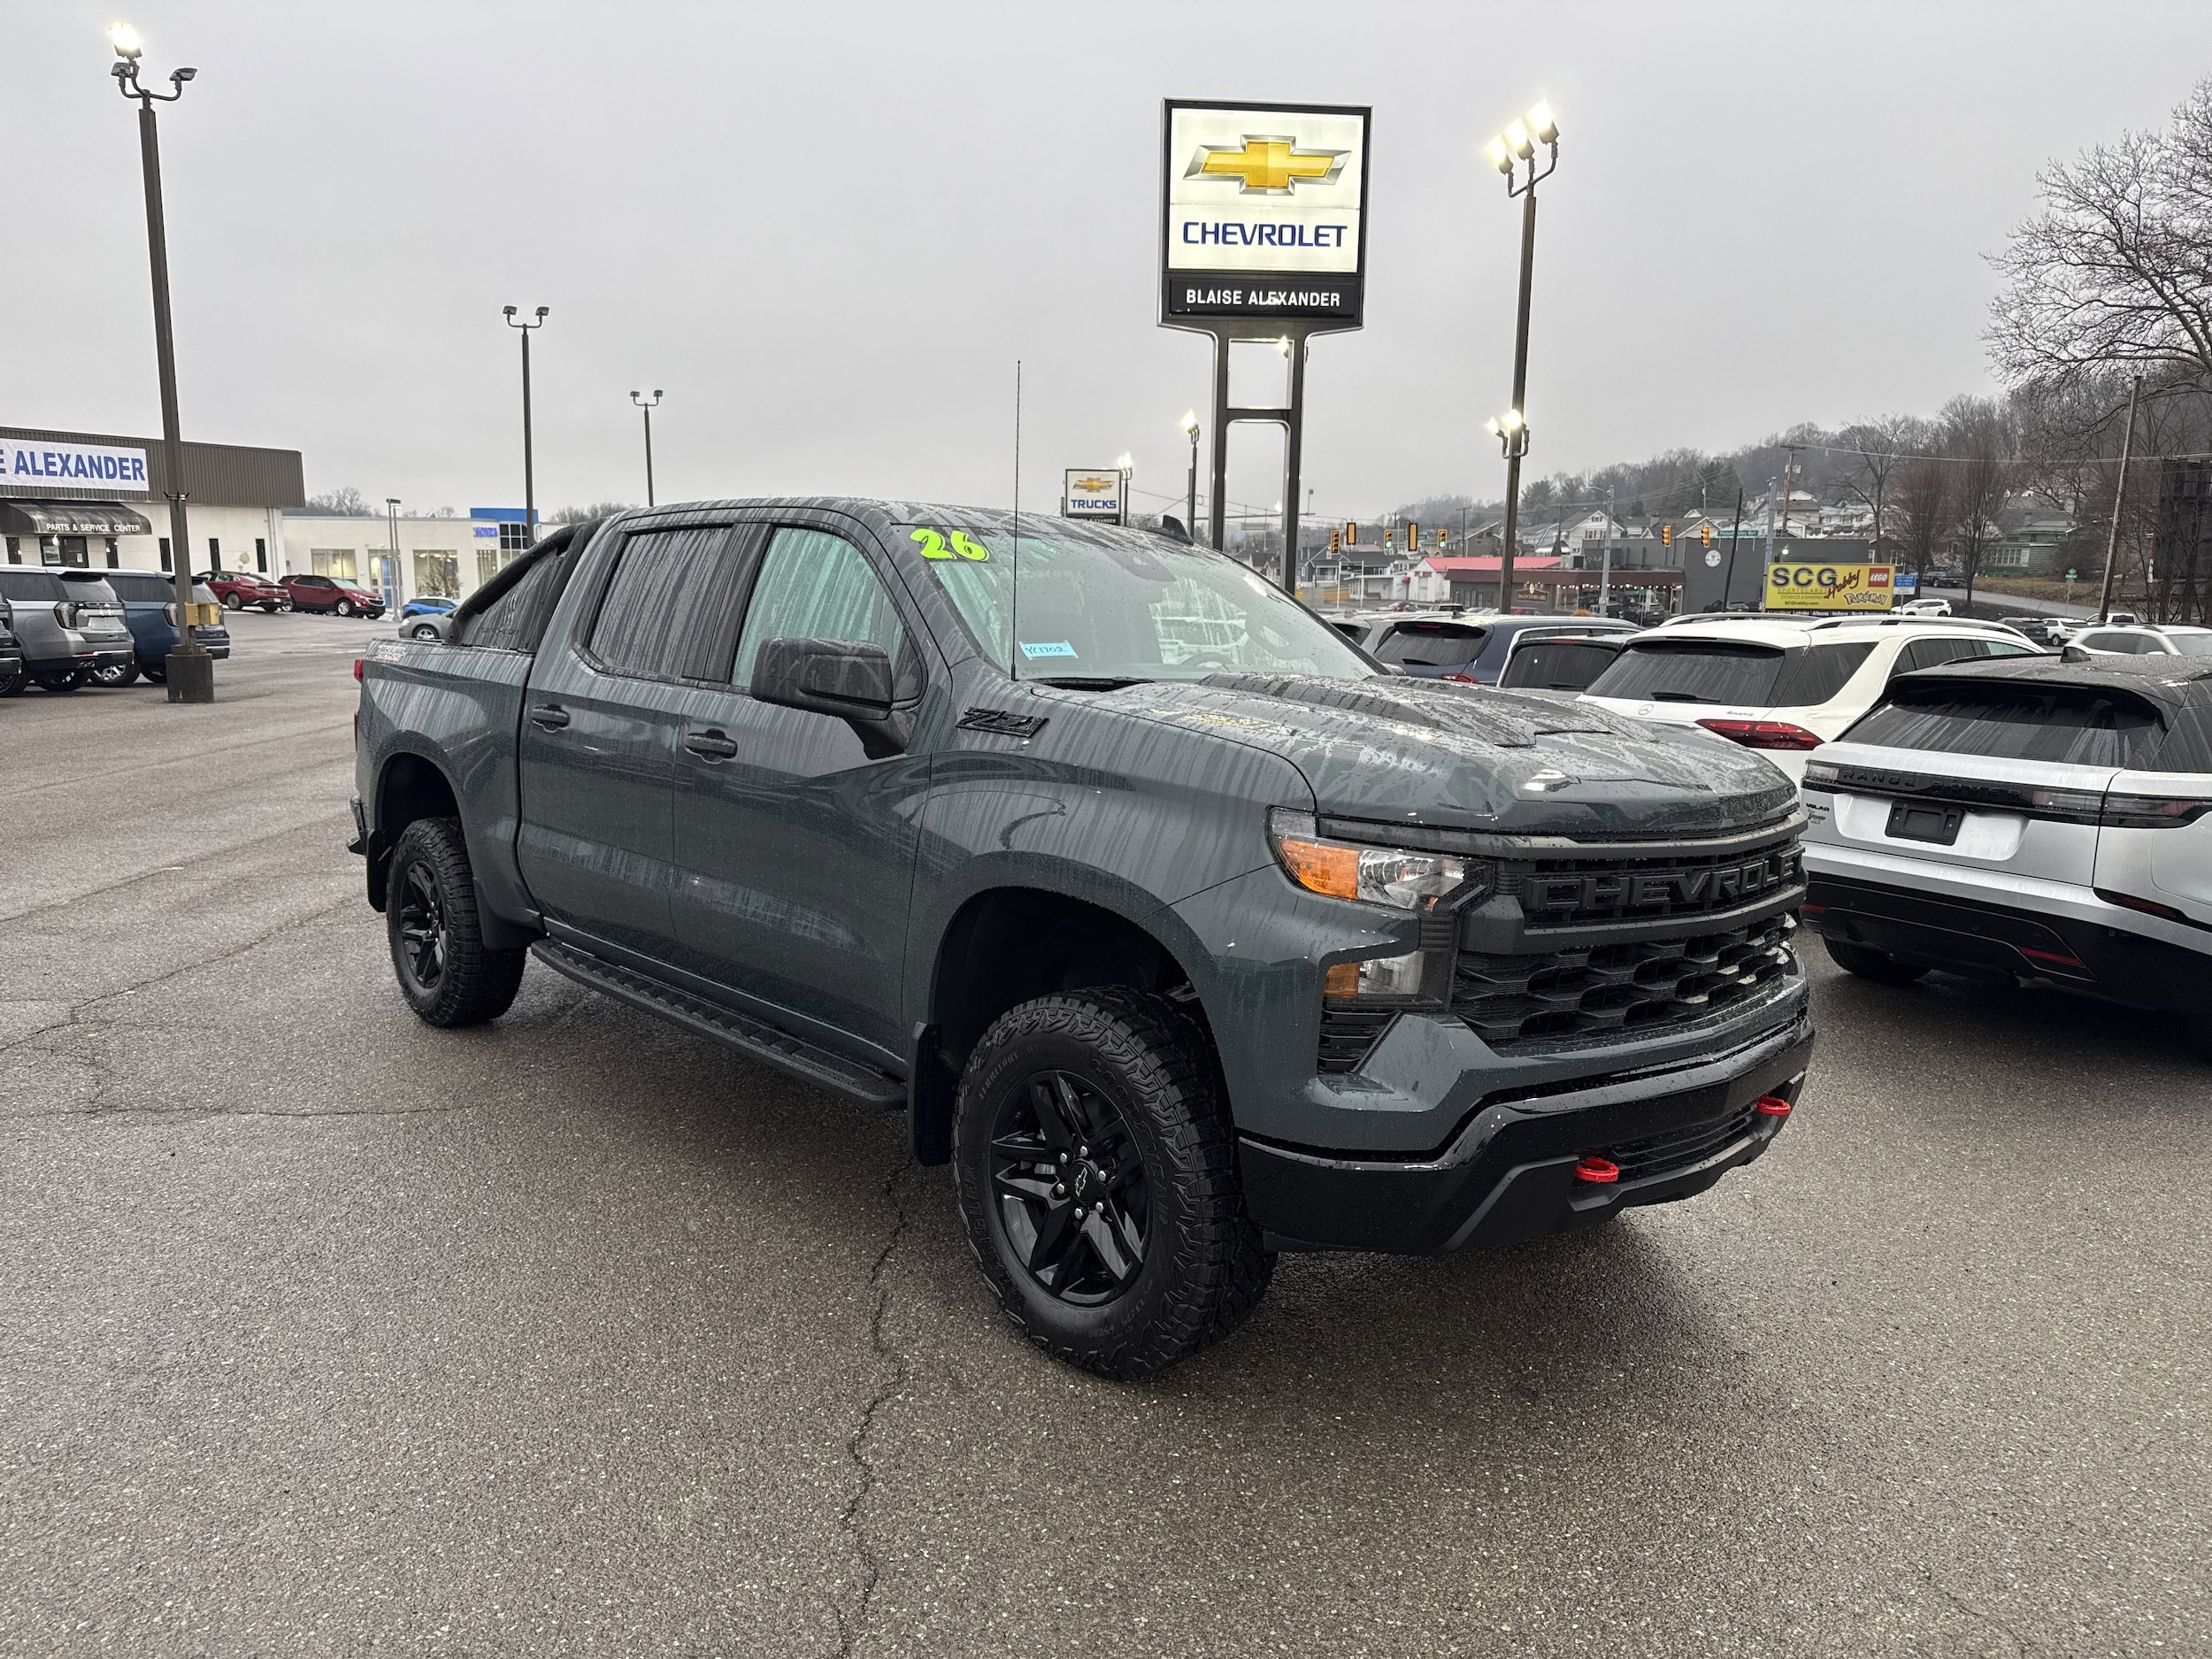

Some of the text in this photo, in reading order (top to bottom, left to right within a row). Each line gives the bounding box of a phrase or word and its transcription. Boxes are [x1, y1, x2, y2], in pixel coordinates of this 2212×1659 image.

[1182, 221, 1348, 249] CHEVROLET
[1186, 288, 1340, 307] BLAISE ALEXANDER
[14, 450, 146, 481] ALEXANDER
[1071, 499, 1117, 509] TRUCKS
[46, 523, 70, 532] PARTS
[80, 523, 111, 532] SERVICE
[113, 524, 141, 533] CENTER
[910, 527, 990, 562] 26
[1771, 567, 1838, 588] SCG
[1842, 772, 2024, 799] RANGE ROVER
